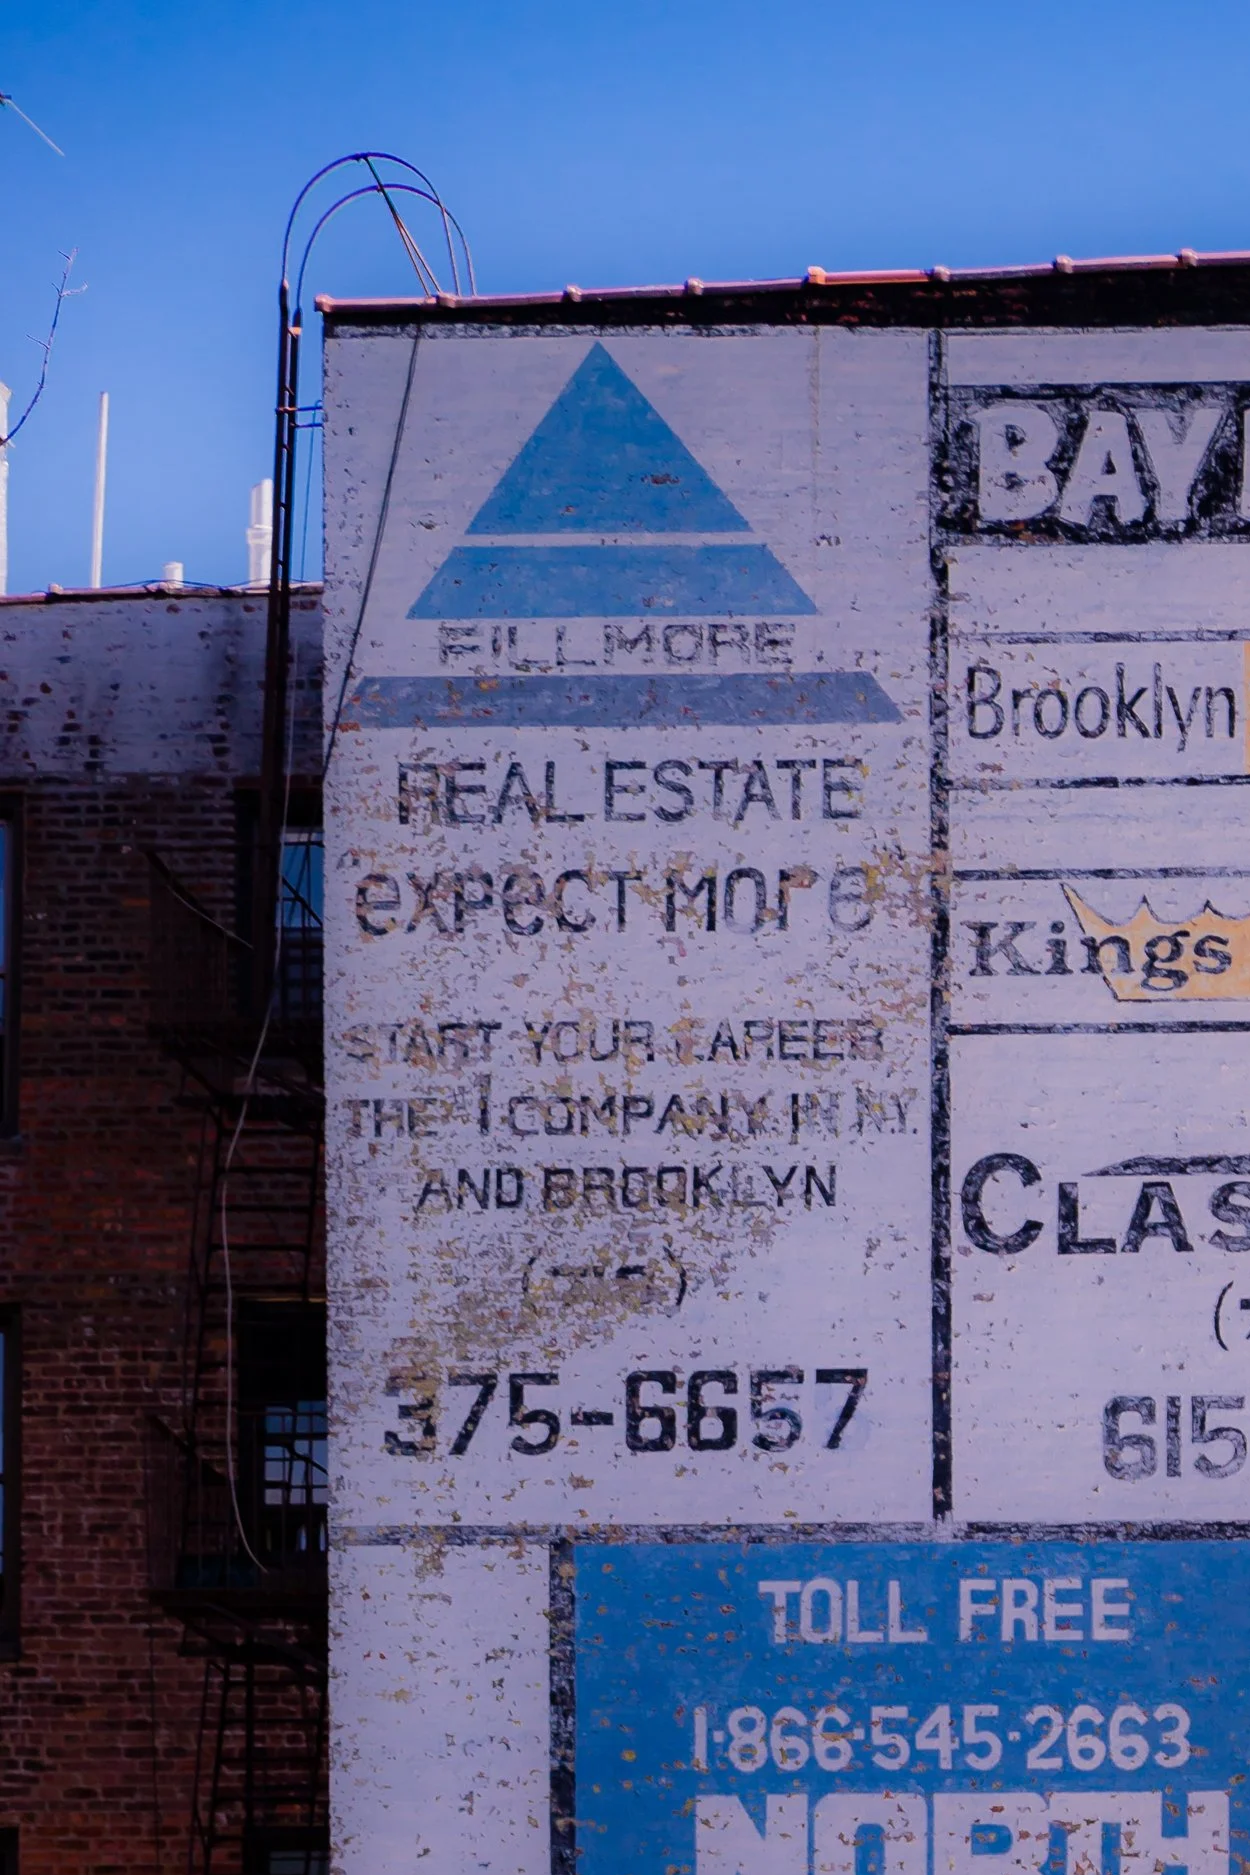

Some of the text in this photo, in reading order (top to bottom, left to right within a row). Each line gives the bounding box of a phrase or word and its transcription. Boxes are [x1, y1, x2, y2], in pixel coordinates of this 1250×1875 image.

[438, 623, 797, 669] FILLMORE
[966, 661, 1237, 752] Brooklyn
[397, 758, 865, 827] REAL ESTATE
[959, 919, 1233, 992] Kings
[346, 1021, 503, 1066] START
[524, 1020, 656, 1064] YOUR
[344, 1097, 438, 1139] THE
[508, 1093, 769, 1140] COMPANY
[414, 1163, 837, 1212] AND BROOKLYN
[384, 1368, 869, 1457] 375-6657
[758, 1577, 1132, 1645] TOLL FREE
